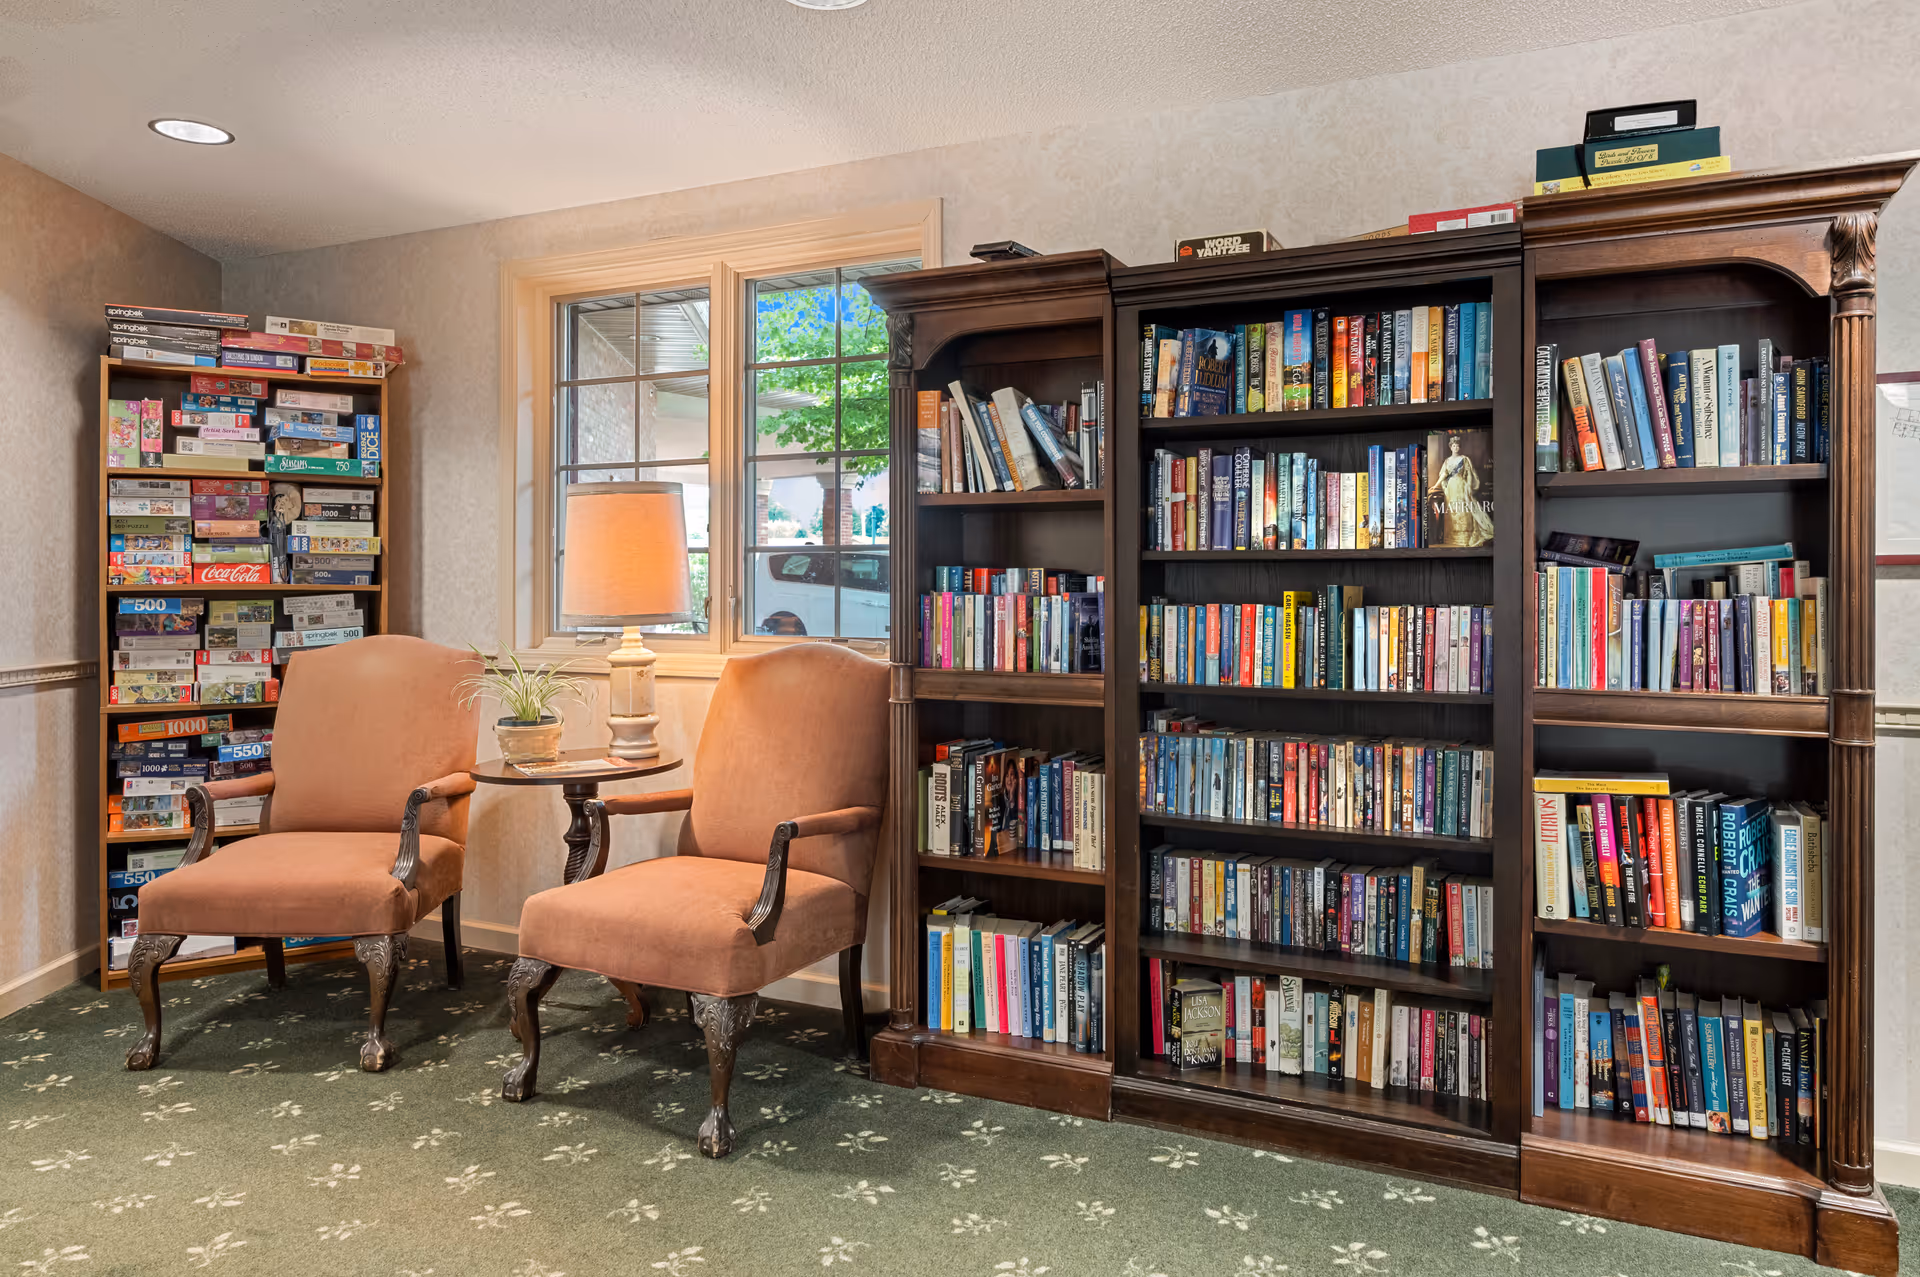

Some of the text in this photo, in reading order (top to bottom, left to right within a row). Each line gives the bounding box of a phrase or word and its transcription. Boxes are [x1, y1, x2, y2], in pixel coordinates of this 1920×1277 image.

[1197, 244, 1250, 257] YAHTZEE
[1205, 236, 1241, 248] WORD
[108, 308, 143, 317] springbok
[113, 323, 148, 332] springbok
[113, 336, 148, 345] springbok
[1383, 314, 1391, 363] KAT MARTIN
[1291, 314, 1302, 398] NORA ROBERTS LEGACY
[1350, 321, 1358, 364] KAT MARTIN
[1397, 329, 1405, 359] MARTIN
[1537, 346, 1550, 359] CAT
[1143, 338, 1153, 391] JAMES PATTERSON
[1702, 358, 1712, 366] A
[1537, 366, 1550, 390] MOUSE
[1703, 366, 1713, 394] Woman
[1567, 362, 1589, 434] JAMES PATTERSON BURN
[1673, 389, 1681, 403] Wise
[1693, 358, 1703, 438] Barbara Taylor Bradford
[1704, 402, 1714, 439] Substance
[1777, 394, 1786, 443] Janet Evanovich
[1796, 368, 1805, 458] JOHN SANDFORD NEON PREY
[1675, 416, 1684, 445] Wonderful
[367, 432, 379, 459] DICE
[336, 461, 350, 472] 750
[1242, 454, 1250, 488] CATHERINE
[1238, 500, 1246, 538] WHIPLASH
[202, 565, 263, 582] Coca-Cola
[964, 571, 972, 589] PAUL
[1031, 571, 1040, 590] KITTY
[134, 599, 166, 610] 500
[305, 630, 359, 640] springbok 500
[1264, 625, 1273, 663] JANET EVANOVICH
[168, 719, 207, 736] 1000
[233, 745, 262, 758] 550
[142, 764, 160, 773] 1000
[935, 772, 947, 801] ROOTS
[976, 776, 984, 804] Garten
[1040, 774, 1048, 821] JAMES PATTERSON
[1537, 798, 1558, 844] SCARLETT
[1622, 828, 1631, 853] CONNELLY
[1662, 808, 1673, 874] CHARLES TODD
[1808, 832, 1817, 873] Bathsheba
[1597, 803, 1615, 907] MICHAEL CONNELLY THE DARK HOURS
[1695, 807, 1707, 913] MICHAEL CONNELLY ECHO PARK
[1722, 812, 1737, 917] ROBERT CRAIS
[1784, 829, 1798, 906] EAGLE AGAINST THE SUN
[124, 870, 156, 884] 550
[1625, 867, 1633, 876] THE
[1626, 877, 1634, 891] NIGHT
[1058, 961, 1066, 975] JANE
[1076, 961, 1085, 1014] SHADOW PLAY
[1184, 1006, 1221, 1022] JACKSON
[1645, 1004, 1660, 1056] JANET EVANOVICH
[1704, 1023, 1715, 1070] SUSAN MALLERY
[1781, 1047, 1790, 1071] CLIENT
[1782, 1072, 1791, 1086] LIST
